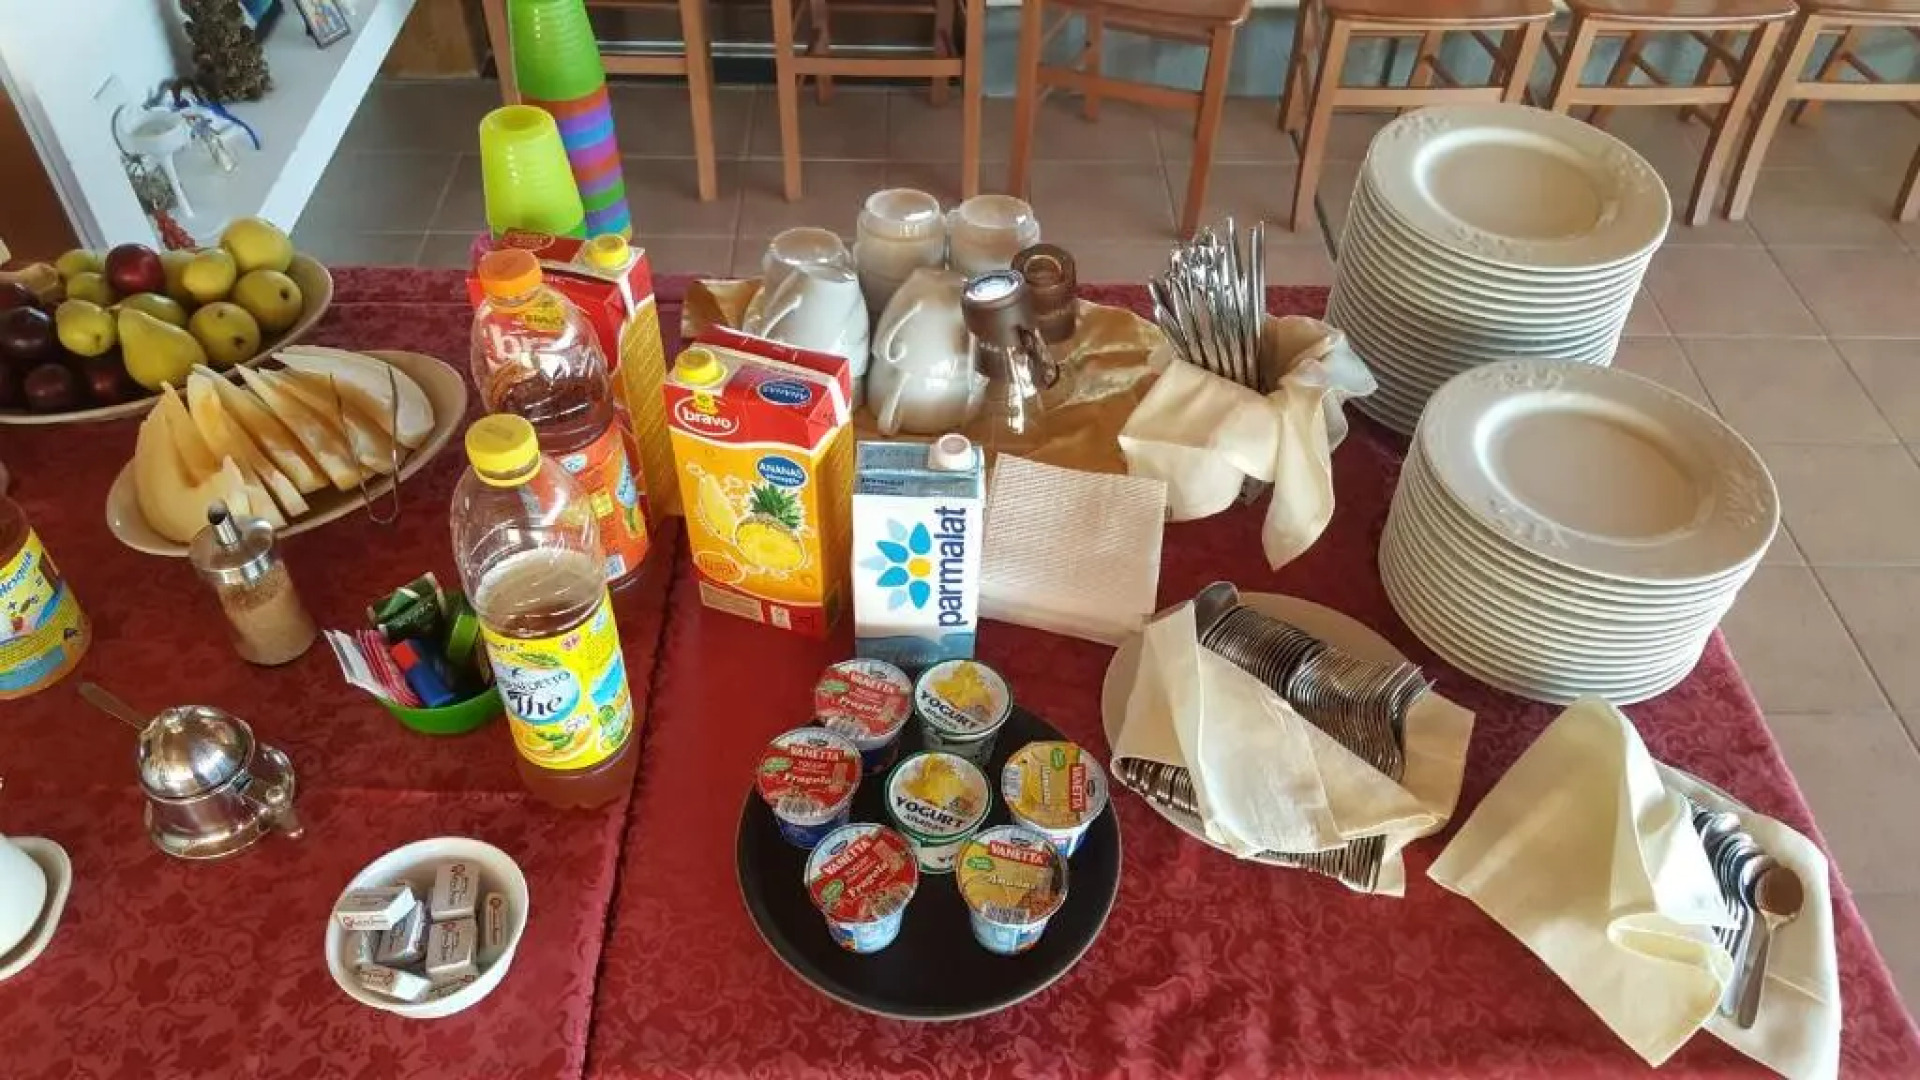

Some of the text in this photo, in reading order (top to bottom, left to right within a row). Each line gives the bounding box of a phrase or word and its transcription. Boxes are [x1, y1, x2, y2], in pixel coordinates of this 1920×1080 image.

[682, 406, 732, 430] bravo
[933, 505, 968, 627] parmalat
[920, 689, 978, 730] YOGURT
[790, 746, 840, 761] VANETTA
[896, 796, 964, 829] YOGURT
[990, 842, 1044, 866] VANETTA
